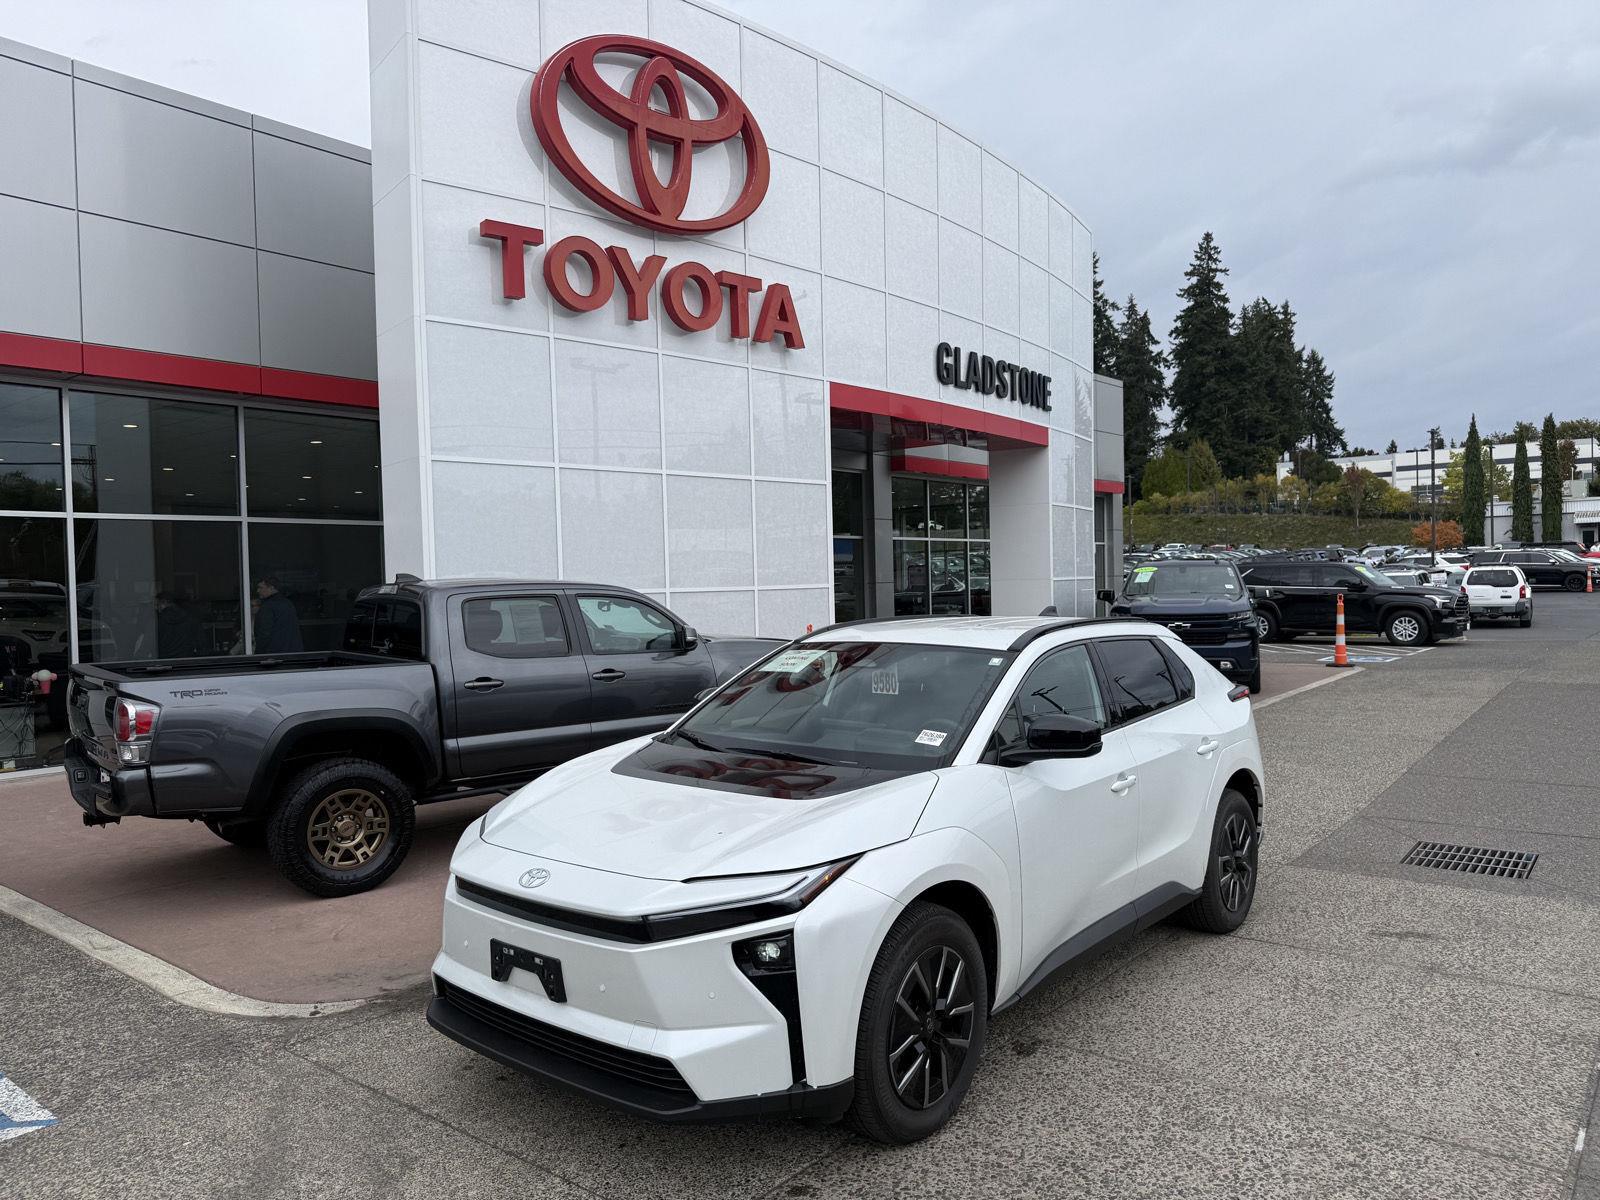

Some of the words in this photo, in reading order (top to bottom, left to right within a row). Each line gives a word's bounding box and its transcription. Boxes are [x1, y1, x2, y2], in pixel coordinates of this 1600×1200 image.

[479, 218, 806, 350] TOYOTA
[936, 341, 1052, 411] GLADSTONE
[169, 689, 203, 699] TRD
